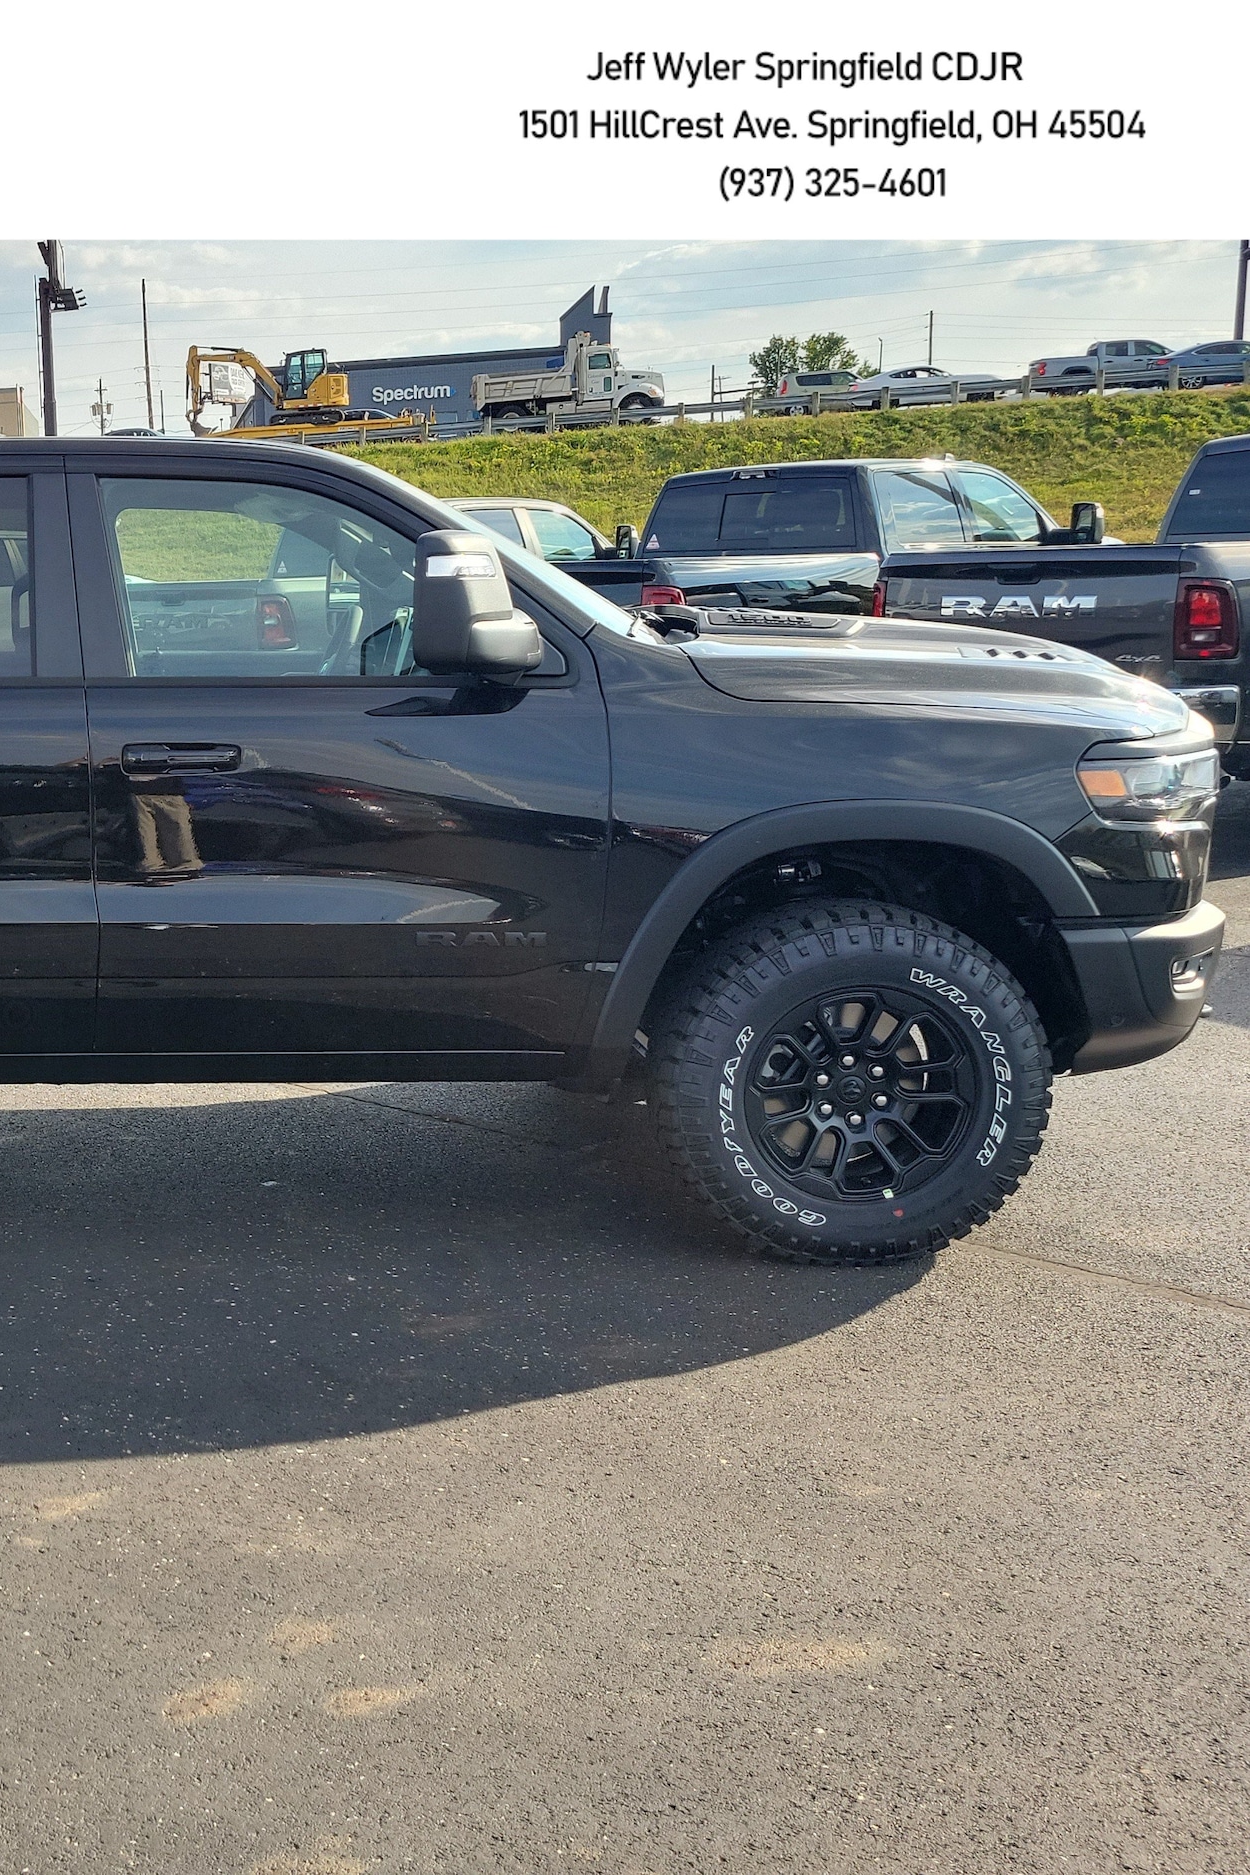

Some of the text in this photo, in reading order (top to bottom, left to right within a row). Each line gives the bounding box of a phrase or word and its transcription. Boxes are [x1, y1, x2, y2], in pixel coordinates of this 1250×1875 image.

[372, 385, 450, 405] Spectrum
[940, 595, 1098, 618] RAM
[416, 931, 547, 947] RAM
[909, 967, 1013, 1167] WRANGLER
[718, 1025, 827, 1227] GOODYEAR
